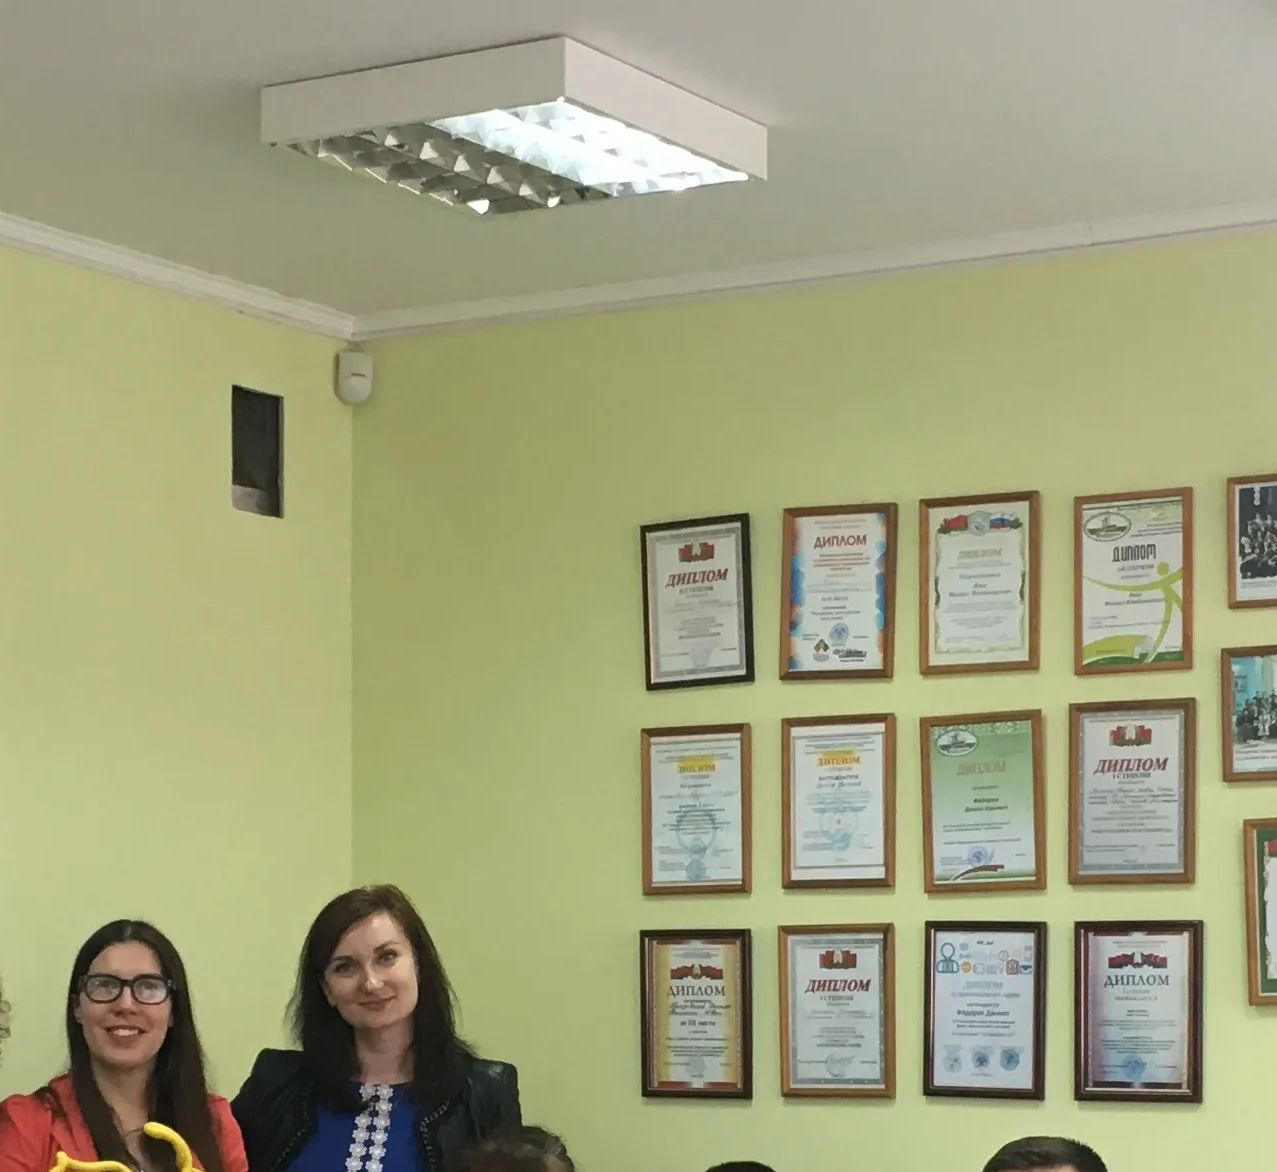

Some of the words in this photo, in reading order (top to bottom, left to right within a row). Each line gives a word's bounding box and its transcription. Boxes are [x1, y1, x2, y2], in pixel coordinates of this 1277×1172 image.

[813, 534, 867, 550] ДИПЛОМ
[665, 568, 728, 588] ДИПЛОМ
[957, 760, 1006, 776] ДИПЛОМ
[1093, 757, 1169, 776] ДИПЛОМ
[805, 979, 871, 994] ДИПЛОМ
[1104, 974, 1171, 988] ДИПЛОМ
[667, 985, 726, 998] ДИПЛОМ
